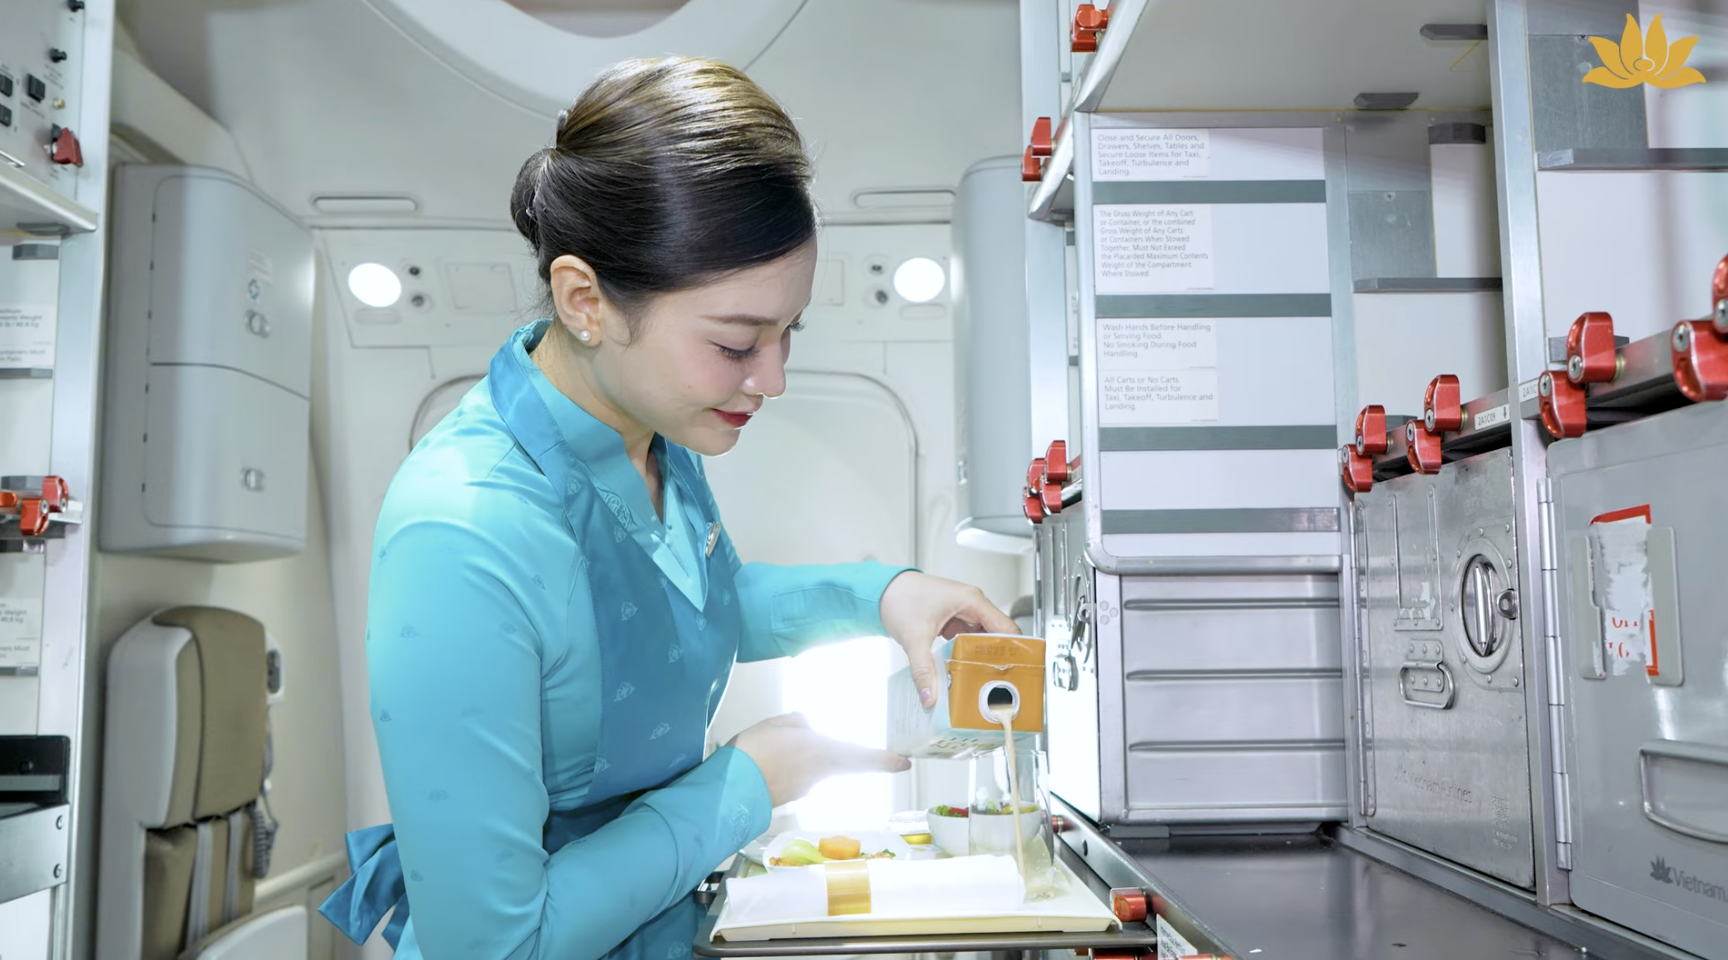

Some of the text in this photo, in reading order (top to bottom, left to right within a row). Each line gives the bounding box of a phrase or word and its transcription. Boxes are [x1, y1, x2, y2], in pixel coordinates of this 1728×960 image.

[1098, 159, 1129, 167] Takeoff,
[1176, 324, 1211, 332] Handling
[1113, 333, 1141, 341] Serving
[1116, 342, 1148, 350] Smoking
[1522, 384, 1538, 397] 2A1C
[1124, 394, 1154, 402] Takeoff,
[1672, 867, 1726, 902] Vietnam
